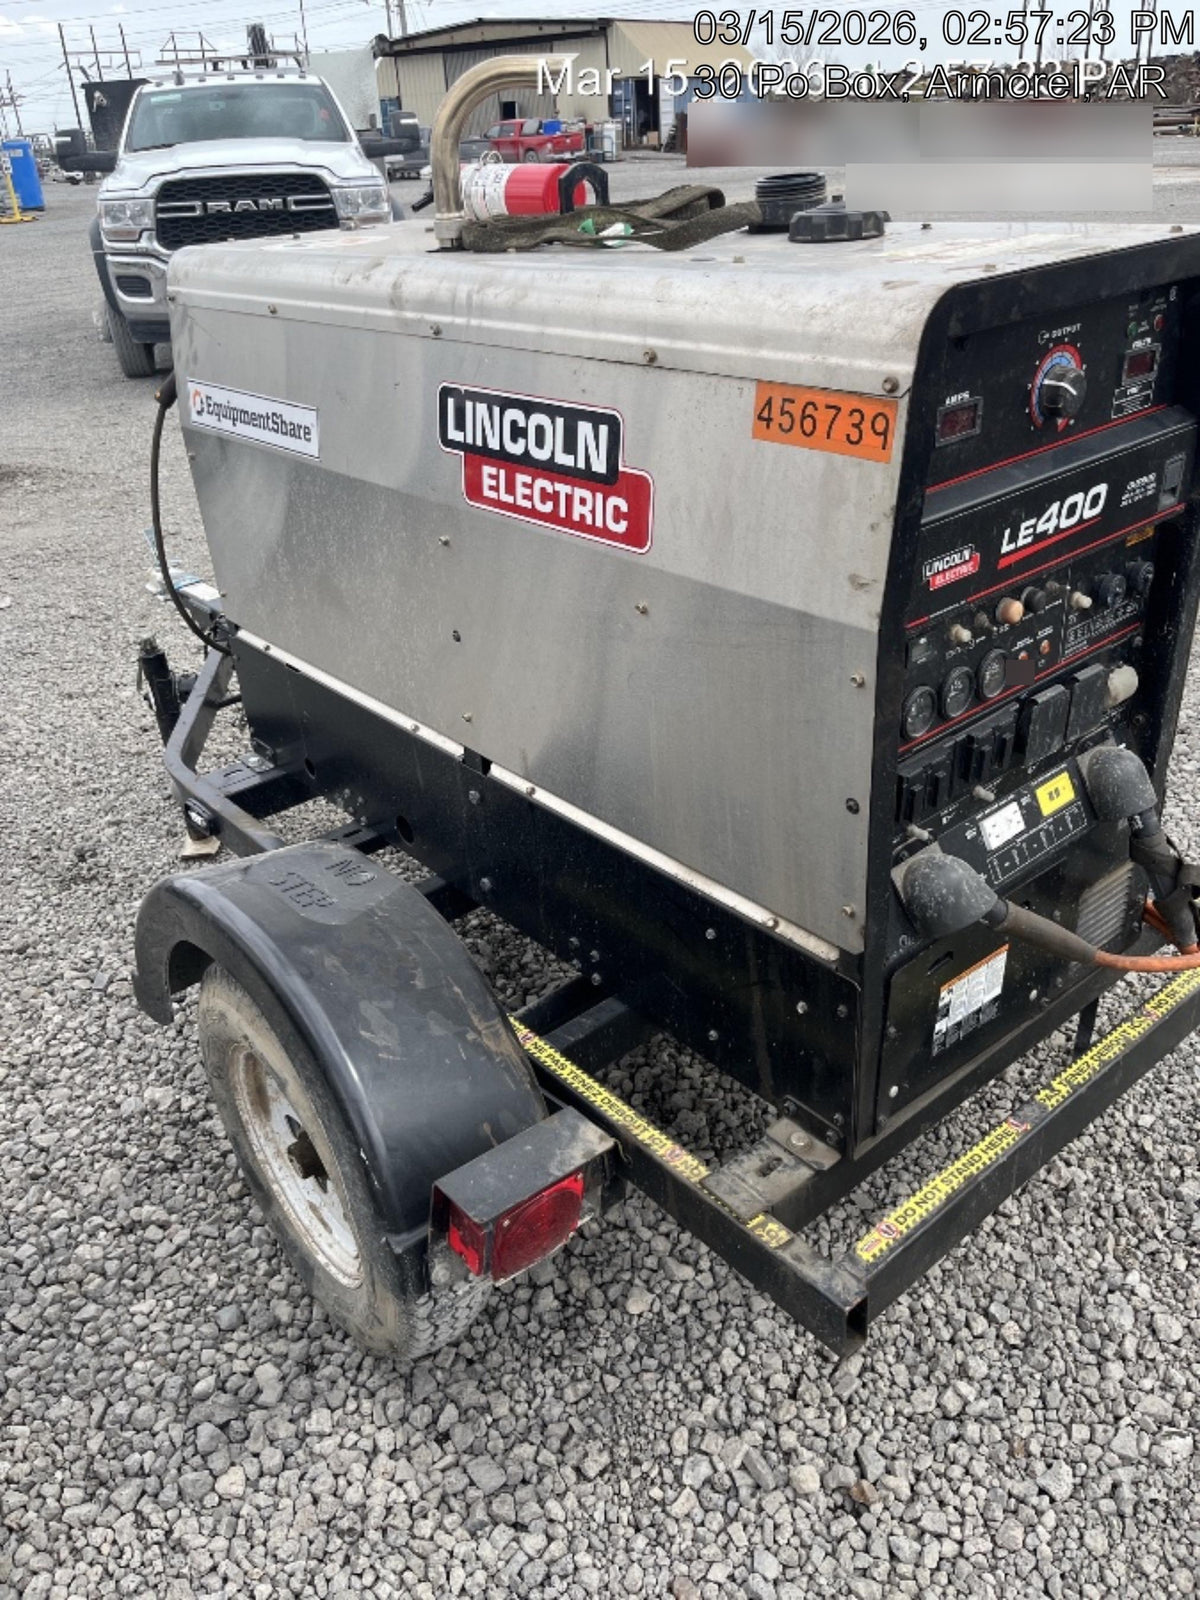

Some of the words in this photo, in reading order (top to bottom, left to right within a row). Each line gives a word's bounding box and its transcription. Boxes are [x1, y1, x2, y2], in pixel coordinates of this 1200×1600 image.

[206, 198, 284, 214] RAM
[205, 394, 312, 442] EquipmentShare
[757, 396, 890, 451] 456739
[944, 390, 971, 406] AMPS
[447, 397, 609, 475] LINCOLN
[481, 464, 629, 534] ELECTRIC
[1000, 483, 1109, 554] LE400
[924, 548, 972, 576] LINCOLN
[266, 872, 338, 909] STEP
[324, 859, 378, 887] NO
[547, 1050, 568, 1072] PAS
[567, 1066, 601, 1098] TENEZ
[600, 1095, 650, 1133] DEBOUT
[894, 1206, 917, 1227] DO
[914, 1182, 943, 1210] NOT
[940, 1152, 983, 1186] STAND
[980, 1127, 1014, 1156] HERE
